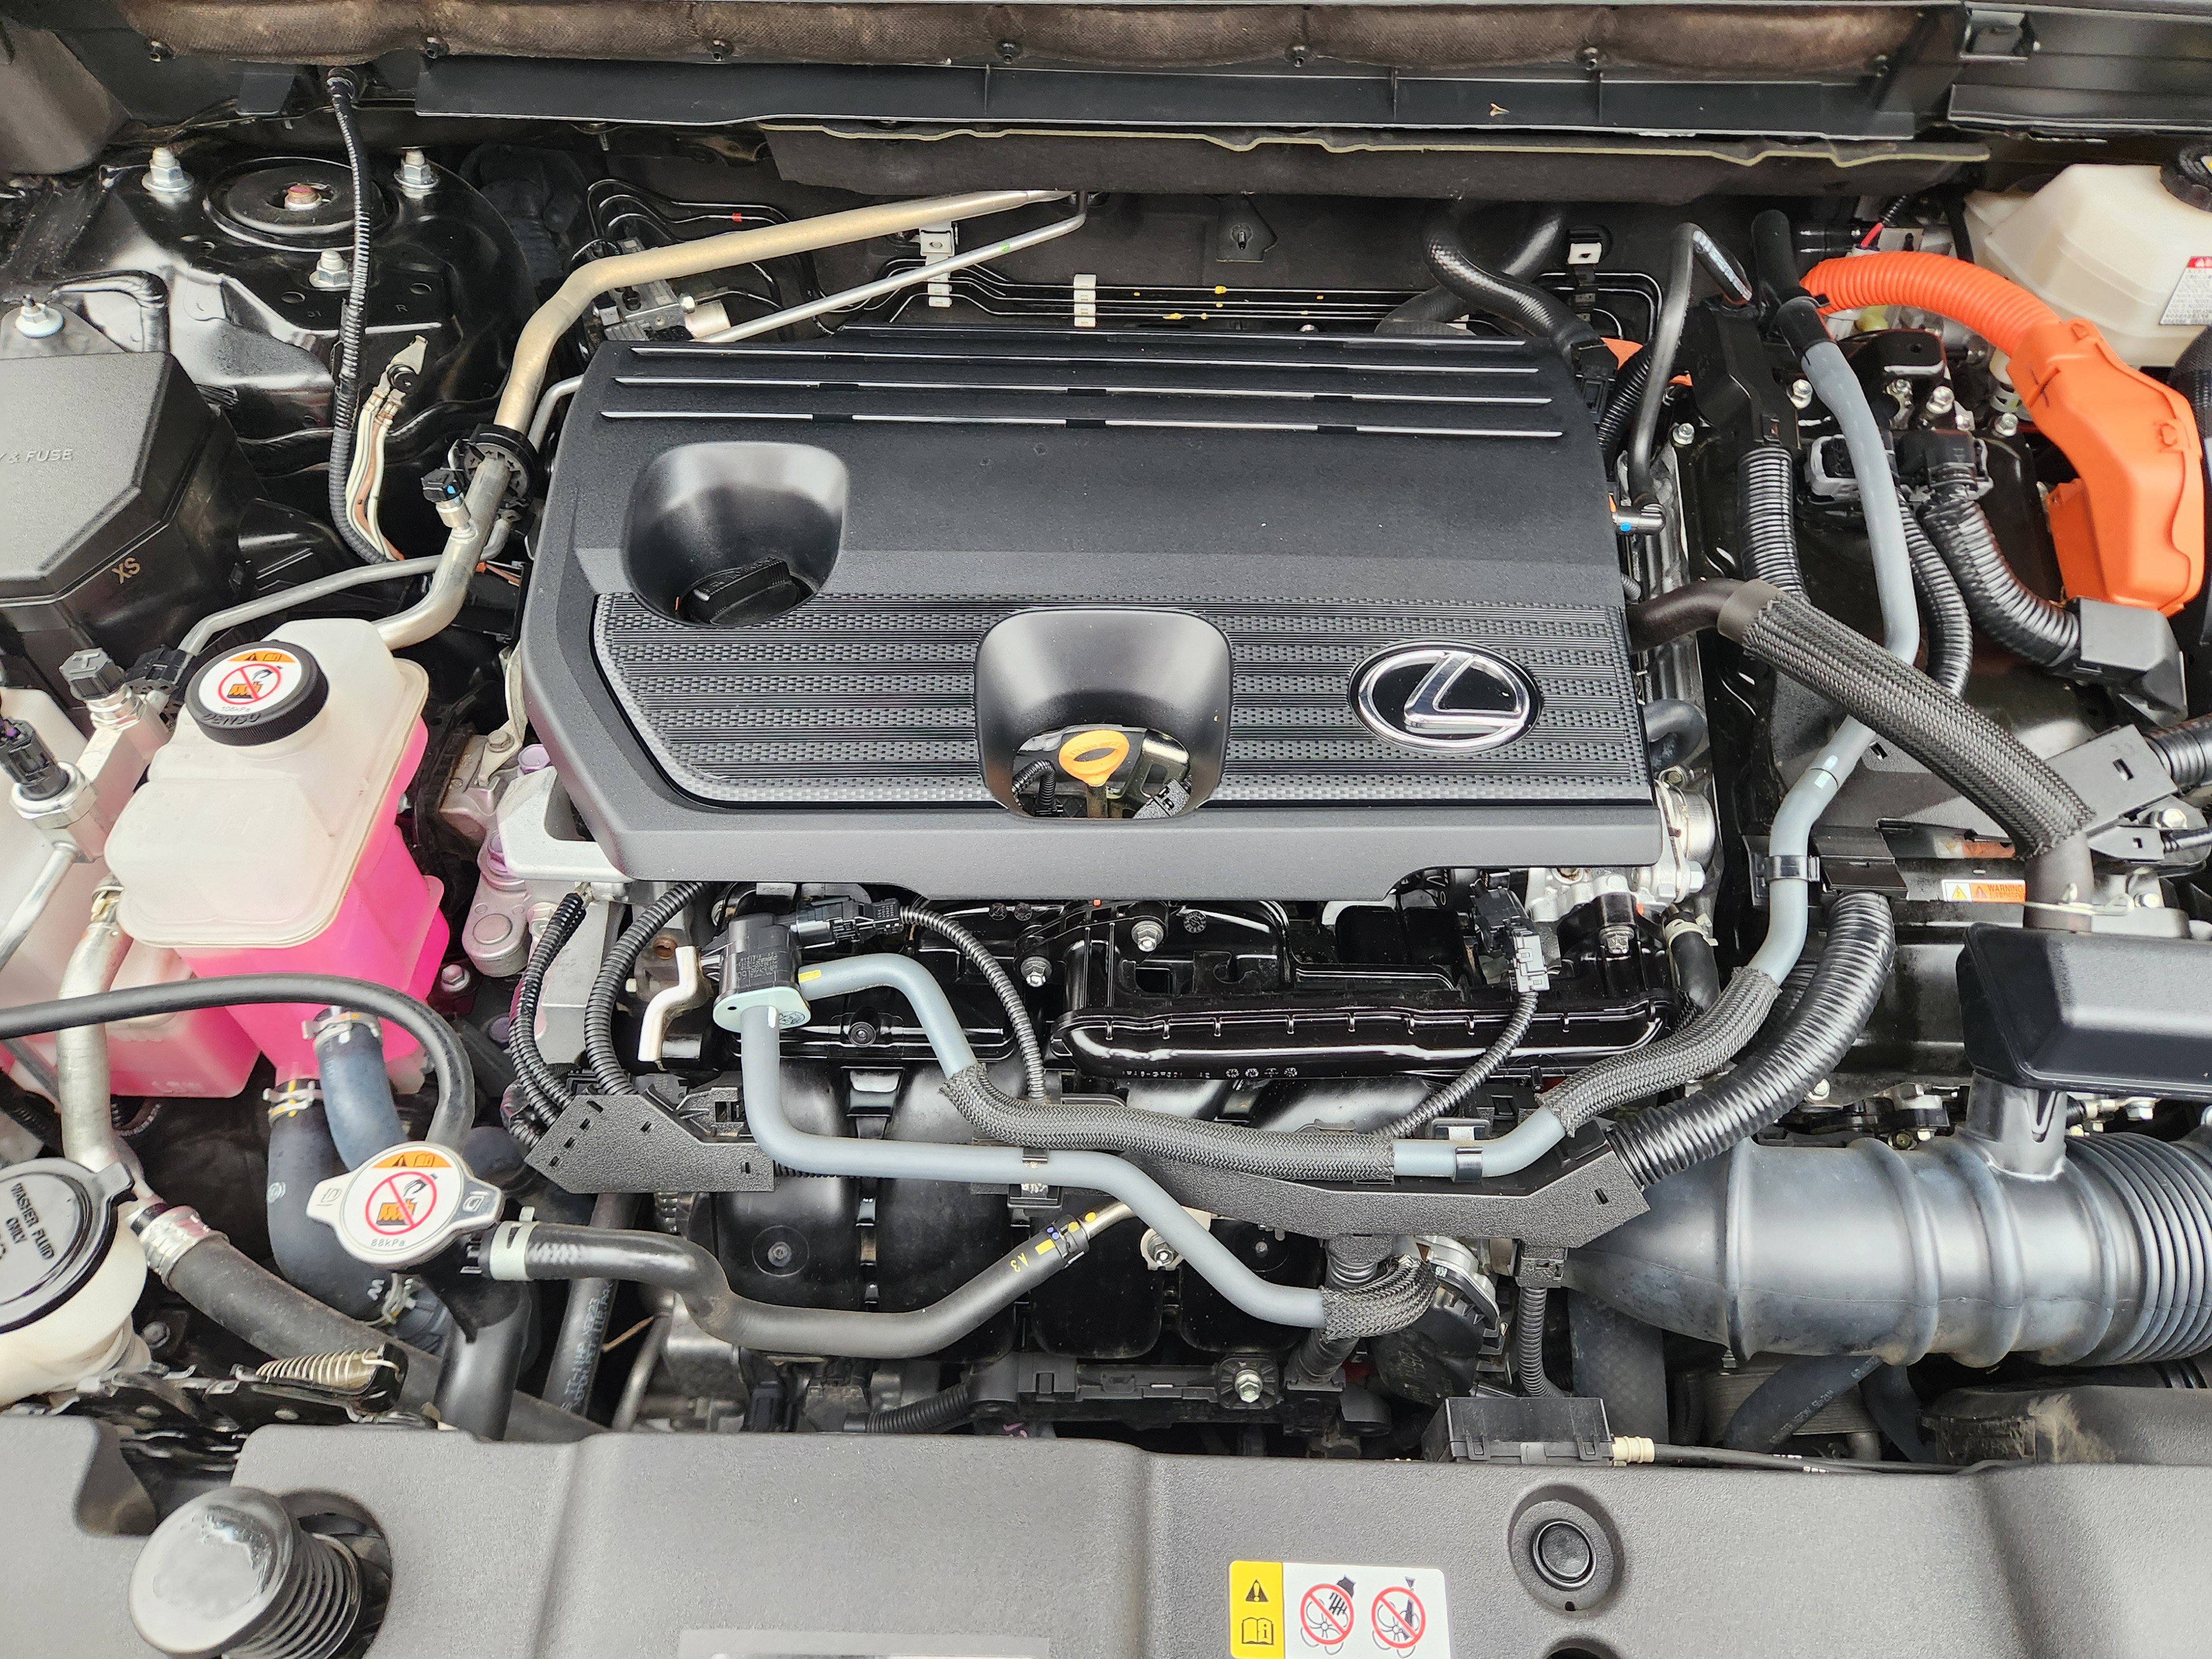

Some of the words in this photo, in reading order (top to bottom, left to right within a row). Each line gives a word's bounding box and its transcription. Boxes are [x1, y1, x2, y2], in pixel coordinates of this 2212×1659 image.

[25, 448, 74, 463] FUSE
[111, 557, 140, 585] XS
[203, 712, 261, 726] DENSO
[6, 1217, 28, 1244] ONLY
[11, 1182, 39, 1228] WASHER
[31, 1228, 55, 1260] FLUID
[371, 1238, 406, 1248] 88kPa
[1010, 1252, 1029, 1272] A3
